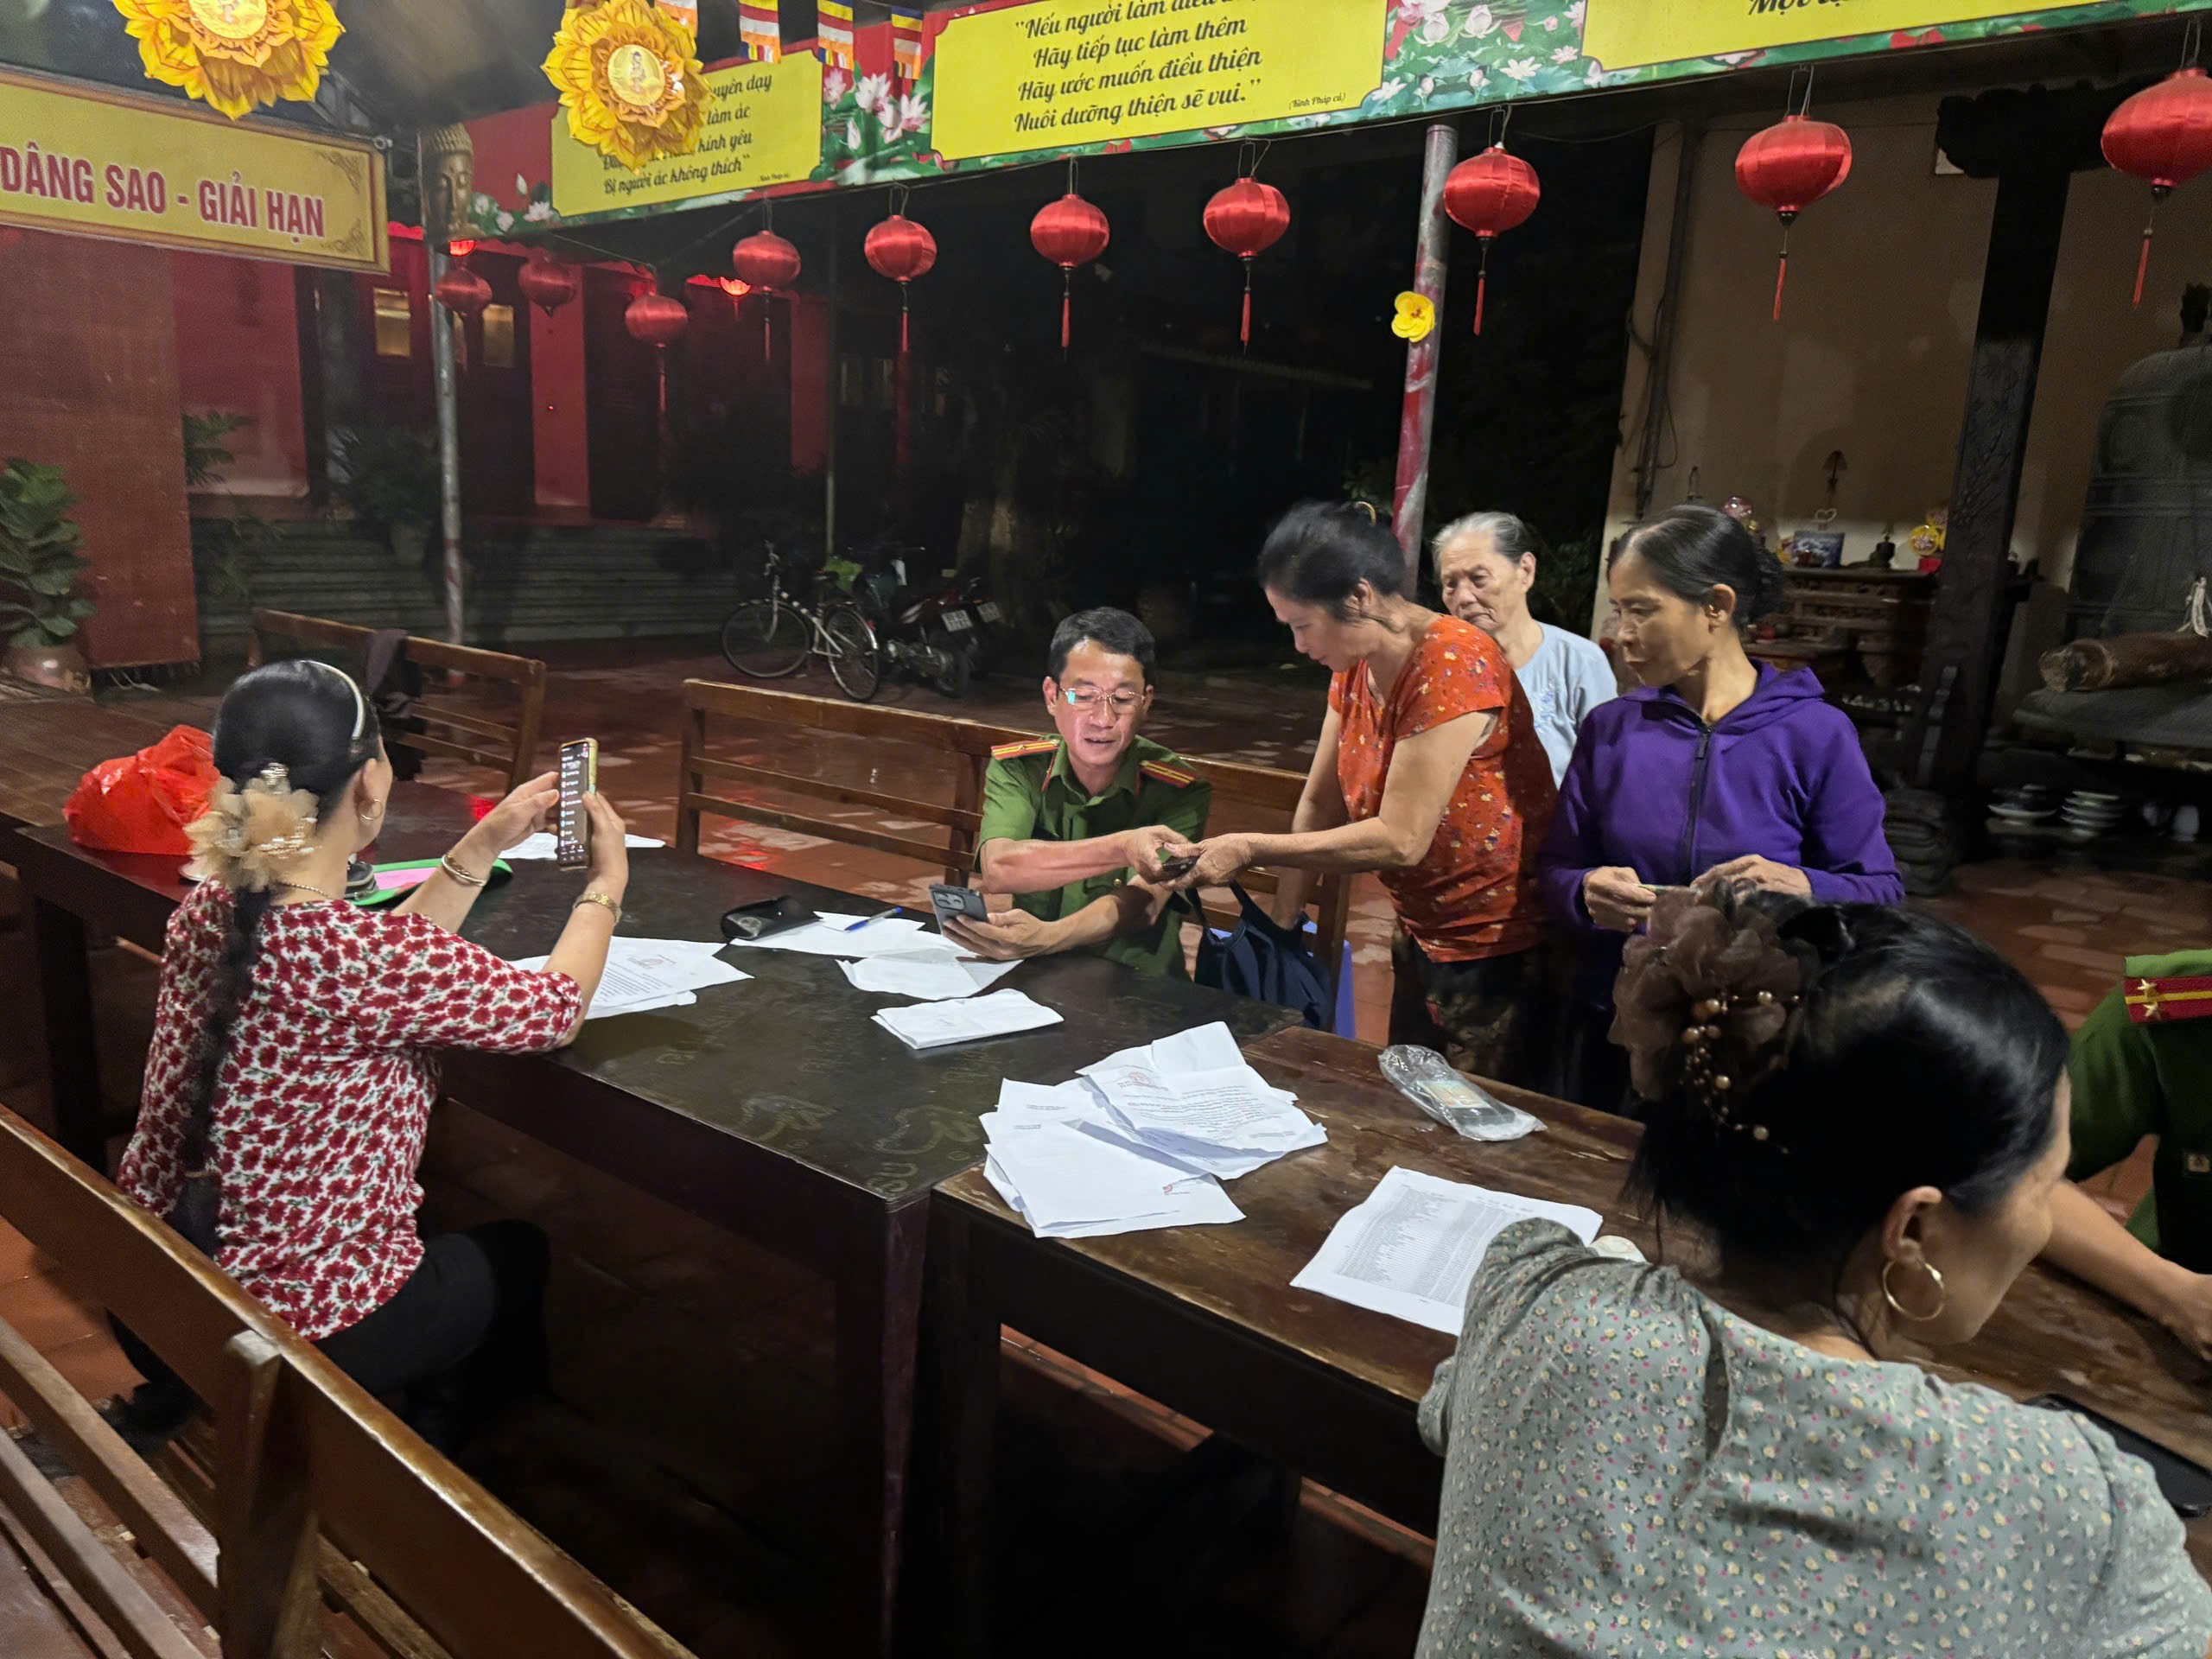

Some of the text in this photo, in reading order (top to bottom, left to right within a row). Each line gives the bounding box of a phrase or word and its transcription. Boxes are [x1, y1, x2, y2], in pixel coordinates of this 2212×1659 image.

[1065, 3, 1122, 35] người
[1126, 0, 1166, 20] làm
[1033, 16, 1247, 69] Hãy tiếp tục làm thêm
[746, 74, 772, 92] dạy
[1019, 46, 1262, 103] Hãy ước muốn điều thiện
[707, 107, 732, 125] làm
[1014, 111, 1057, 132] Nuôi
[1061, 104, 1122, 125] dưỡng
[1128, 93, 1176, 117] thiện
[1181, 89, 1205, 110] sẽ
[0, 142, 95, 204] DÂNG
[105, 164, 166, 214] SAO
[199, 170, 257, 228] GIẢI
[266, 189, 325, 243] HẠN
[618, 173, 652, 195] người
[670, 165, 709, 182] không
